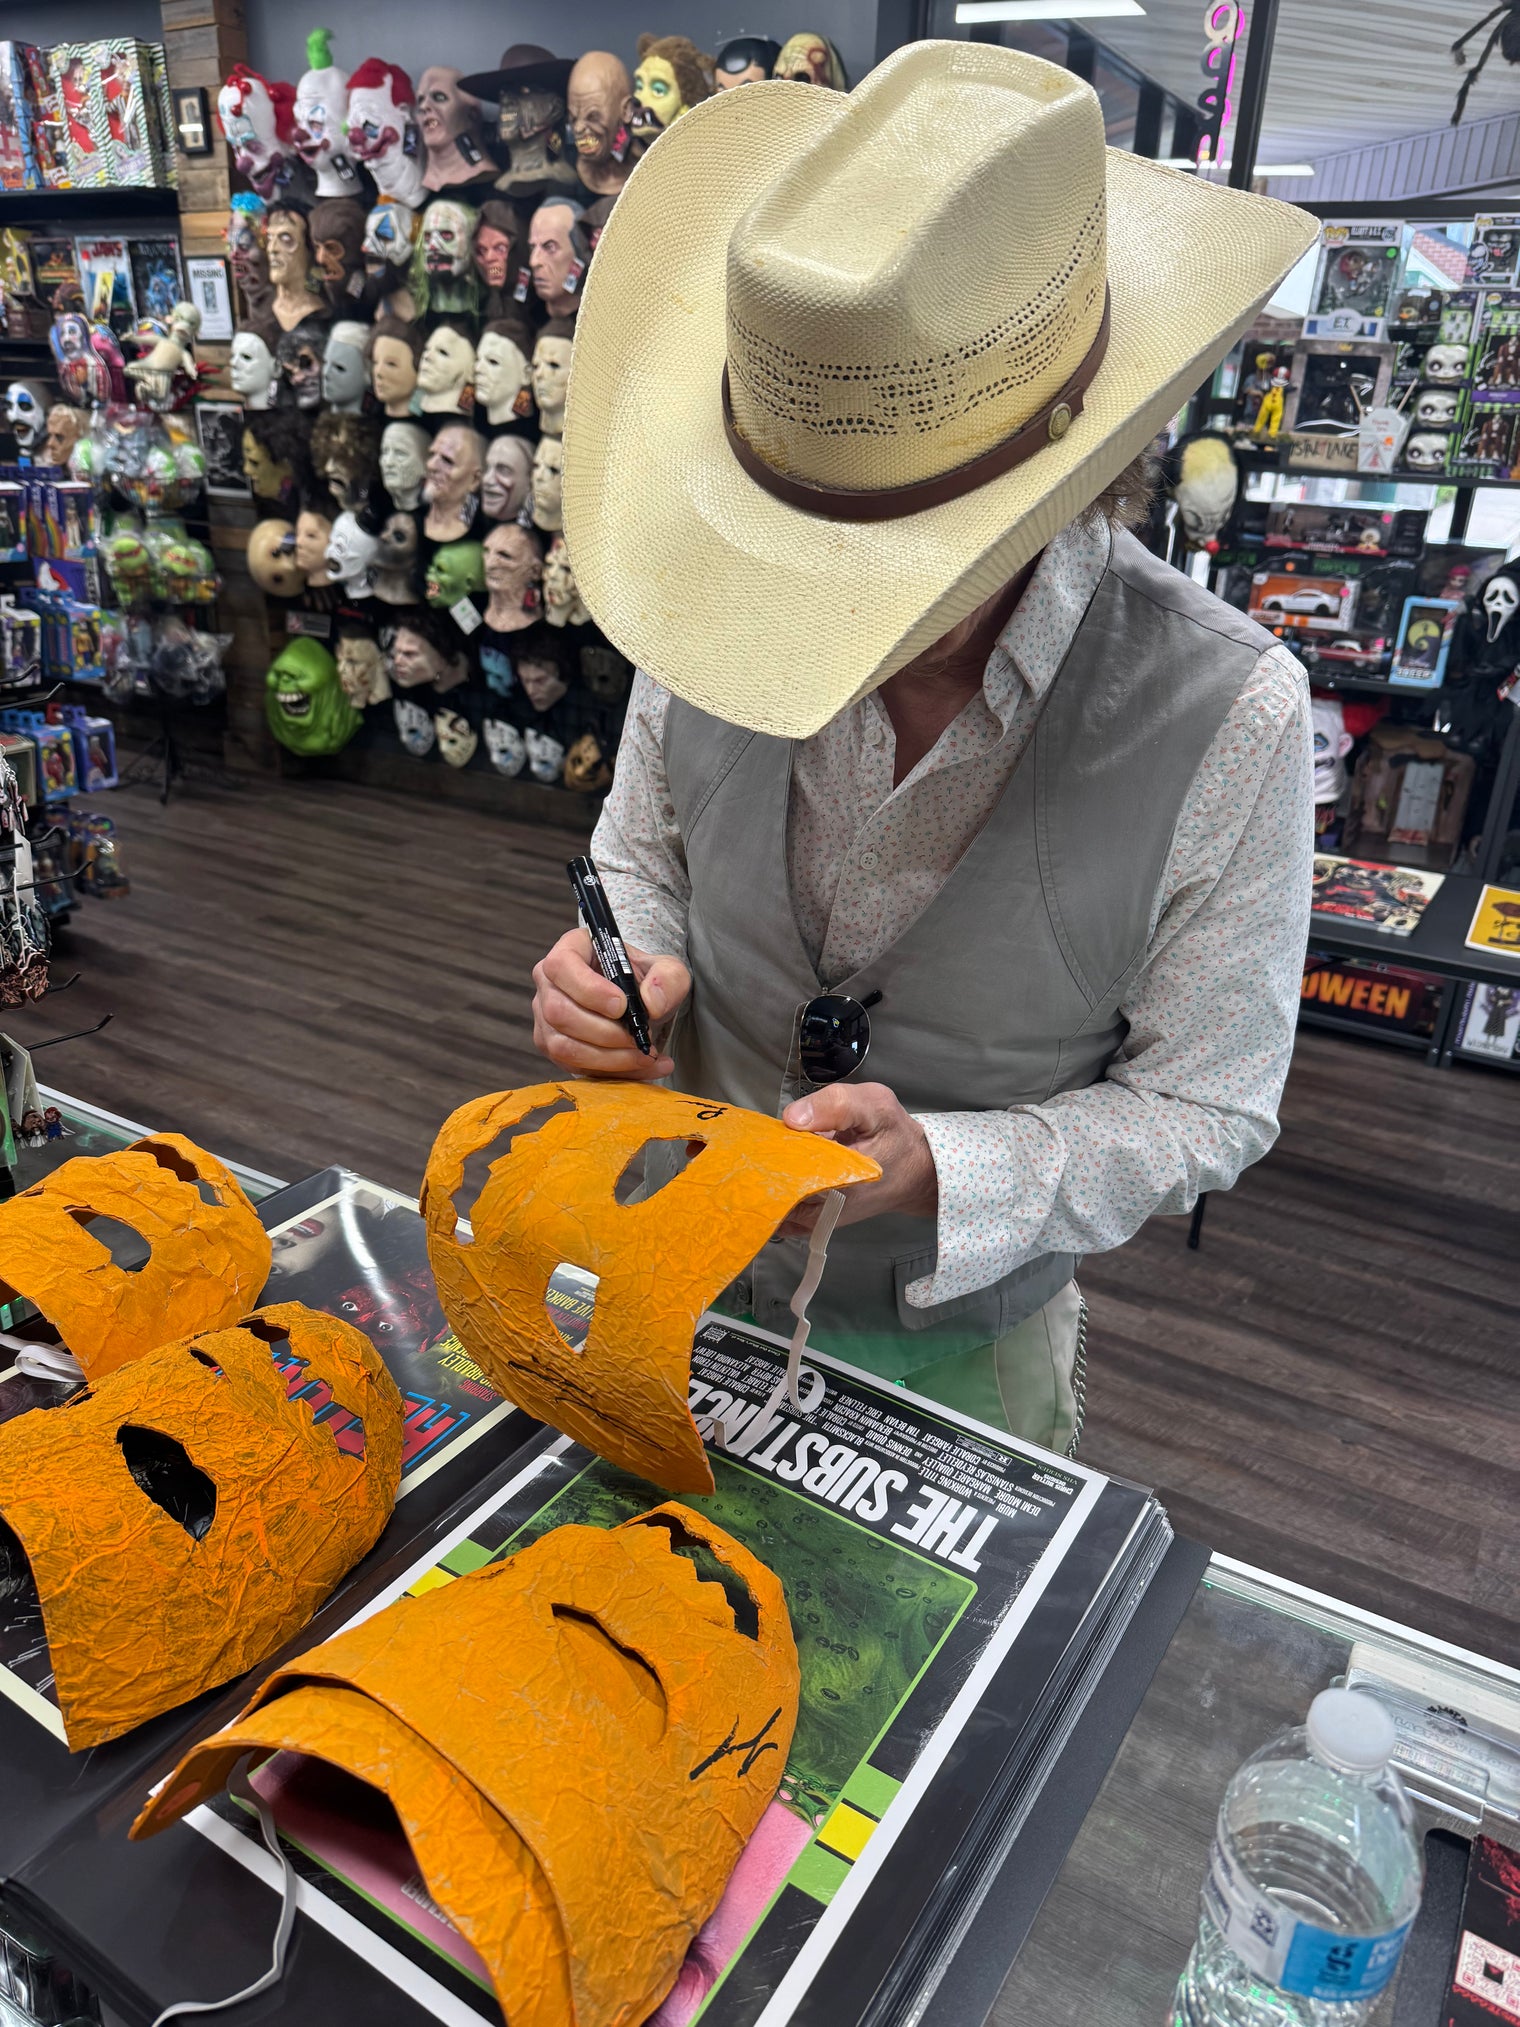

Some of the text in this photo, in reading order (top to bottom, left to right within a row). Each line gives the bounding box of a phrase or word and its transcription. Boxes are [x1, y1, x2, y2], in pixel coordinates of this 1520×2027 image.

[192, 268, 225, 279] MISSING
[691, 1352, 713, 1368] FERON
[692, 1342, 717, 1359] LOEWY
[438, 1353, 485, 1381] BRADLEY
[709, 1359, 741, 1380] VALENTIN
[714, 1351, 751, 1373] ALEXANDRA
[744, 1353, 772, 1371] FARGEAT
[696, 1365, 725, 1384] FARGEAT
[740, 1372, 769, 1391] ELTABET
[749, 1366, 773, 1382] ROYER
[459, 1379, 498, 1402] STARRING
[722, 1375, 750, 1394] CORALIE
[831, 1402, 861, 1421] KRACUN
[837, 1393, 868, 1412] FELLNER
[864, 1405, 883, 1419] ERIC
[818, 1407, 848, 1426] CORALIE
[857, 1414, 893, 1435] BENJAMIN
[882, 1414, 908, 1431] BEVAN
[820, 1420, 865, 1446] BLACKSMITH
[864, 1428, 888, 1445] QUAID
[905, 1424, 921, 1437] TIM
[884, 1438, 913, 1457] DENNIS
[921, 1431, 953, 1452] FARGEAT
[936, 1450, 977, 1475] REYDELLET
[949, 1445, 982, 1465] CORALIE
[997, 1454, 1009, 1463] R
[917, 1465, 940, 1482] TITLE
[920, 1455, 955, 1476] QUALLEY
[936, 1474, 974, 1497] WORKING
[950, 1469, 993, 1494] MARGARET
[973, 1467, 1015, 1492] STANISLAS
[1030, 1471, 1074, 1495] CHRIS BUTLER
[993, 1488, 1022, 1507] MOORE
[994, 1501, 1018, 1518] MUBI
[1019, 1500, 1041, 1516] DEMI
[890, 1485, 999, 1572] THE
